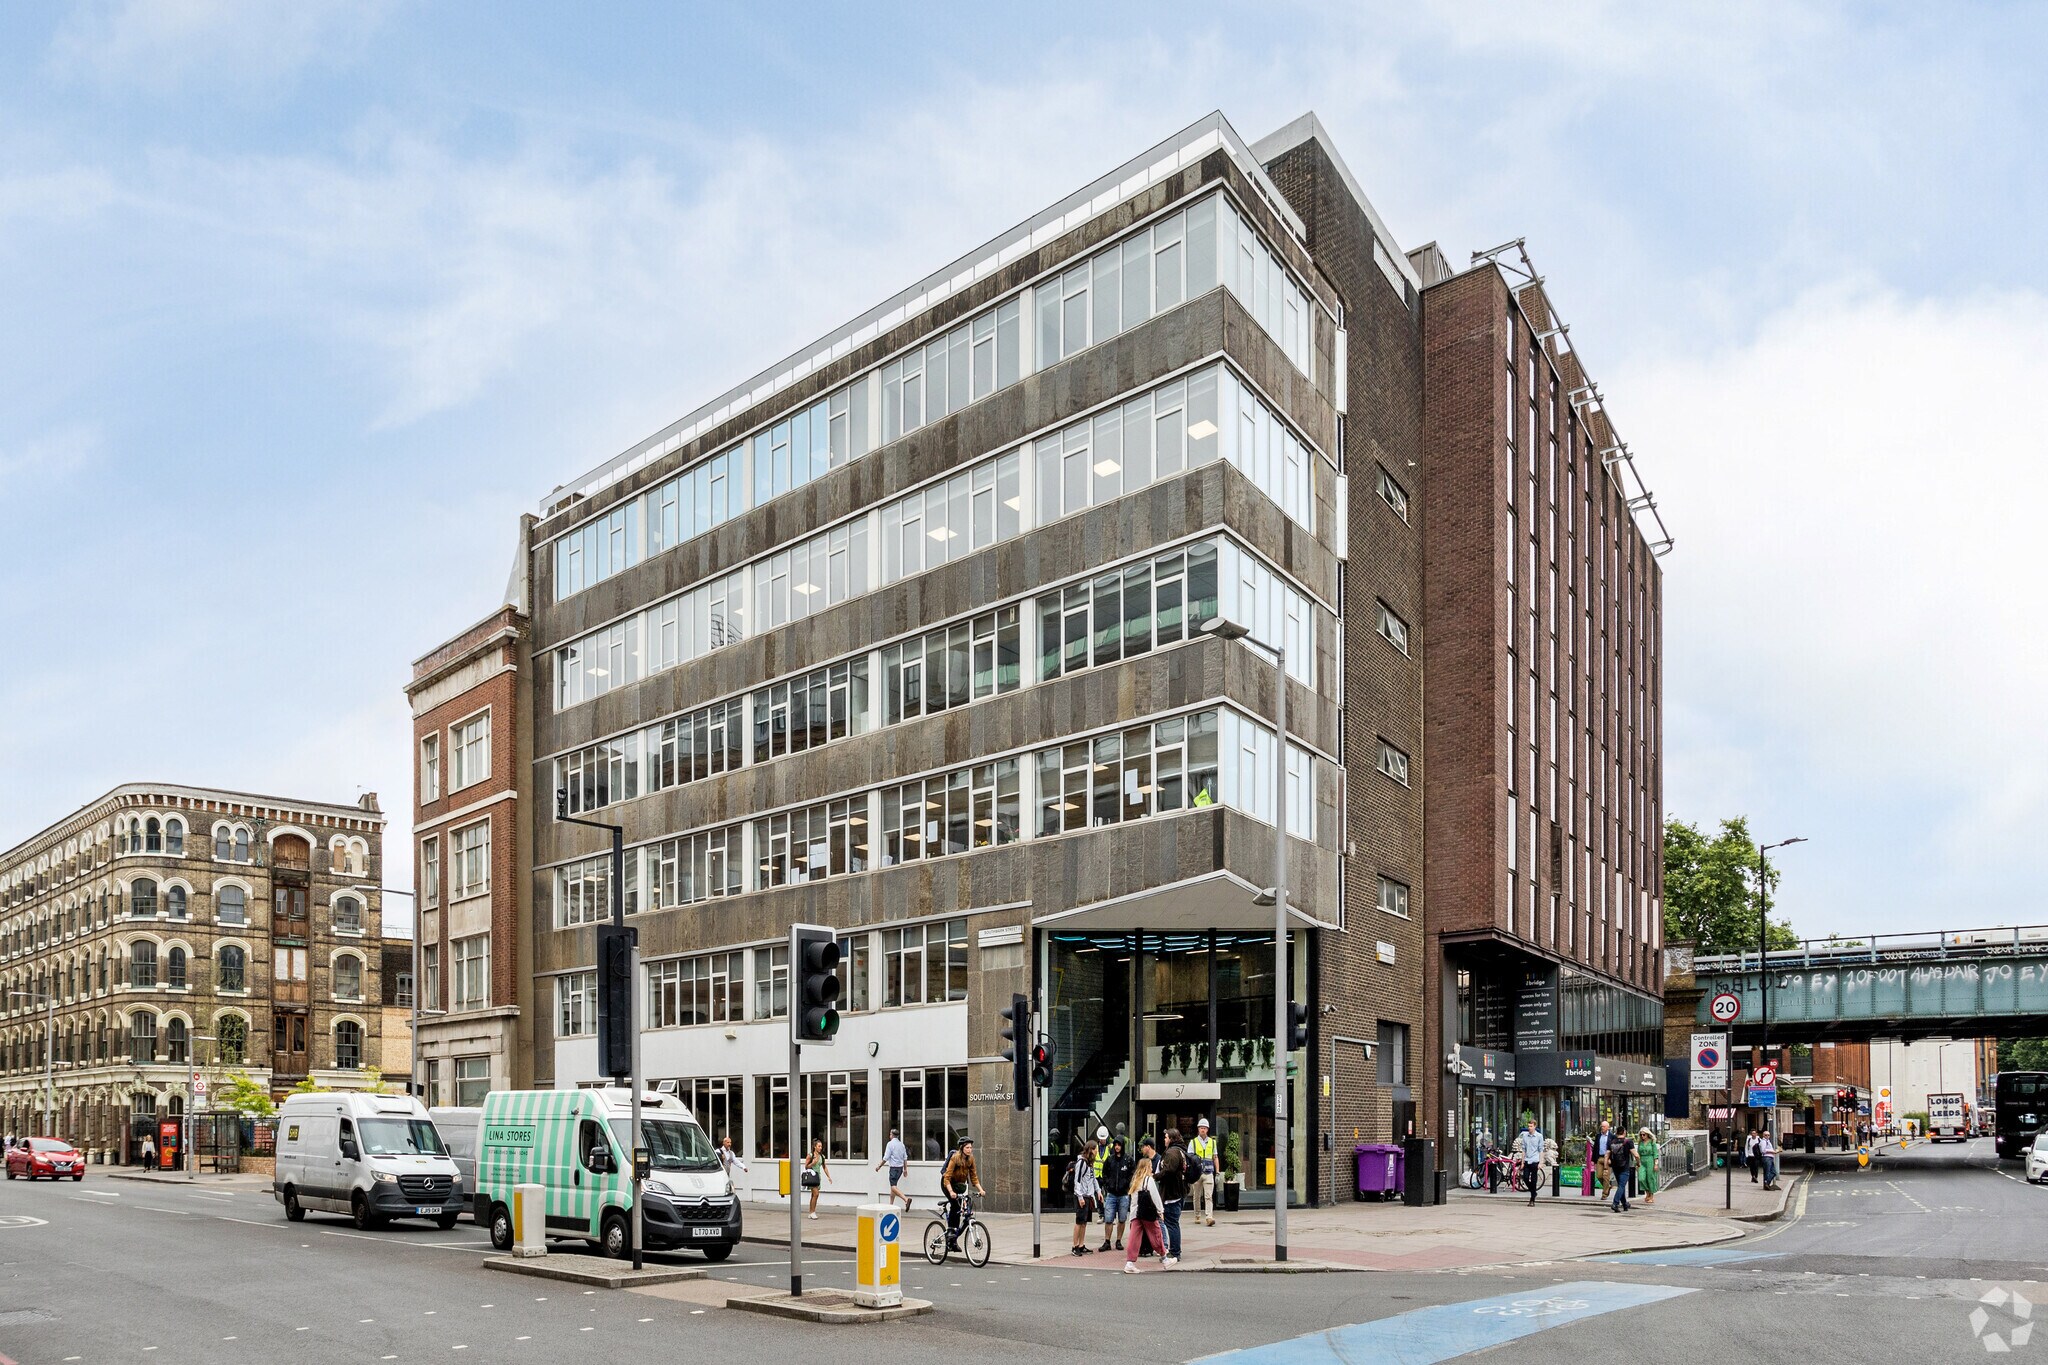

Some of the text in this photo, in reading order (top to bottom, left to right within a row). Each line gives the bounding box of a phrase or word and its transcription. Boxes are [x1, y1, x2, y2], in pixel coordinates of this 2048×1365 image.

[1715, 1001, 1736, 1014] 20
[970, 1092, 1006, 1101] SOUTHWARK
[489, 1131, 531, 1142] LINA STORES
